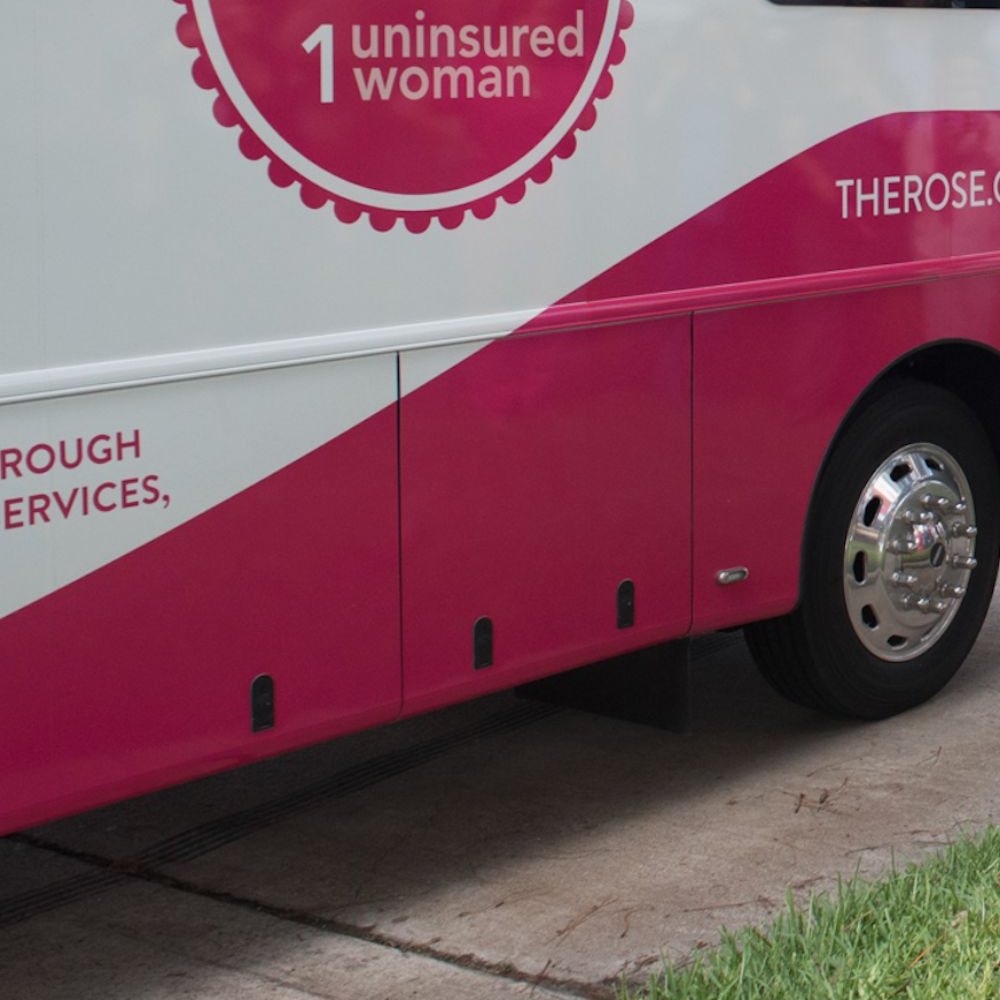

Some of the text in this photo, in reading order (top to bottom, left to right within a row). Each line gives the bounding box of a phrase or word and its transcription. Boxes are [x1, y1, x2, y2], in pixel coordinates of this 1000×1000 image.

[351, 11, 585, 58] uninsured
[301, 24, 334, 104] 1
[353, 68, 531, 101] woman
[0, 429, 140, 480] ROUGH
[4, 475, 170, 530] ERVICES,
